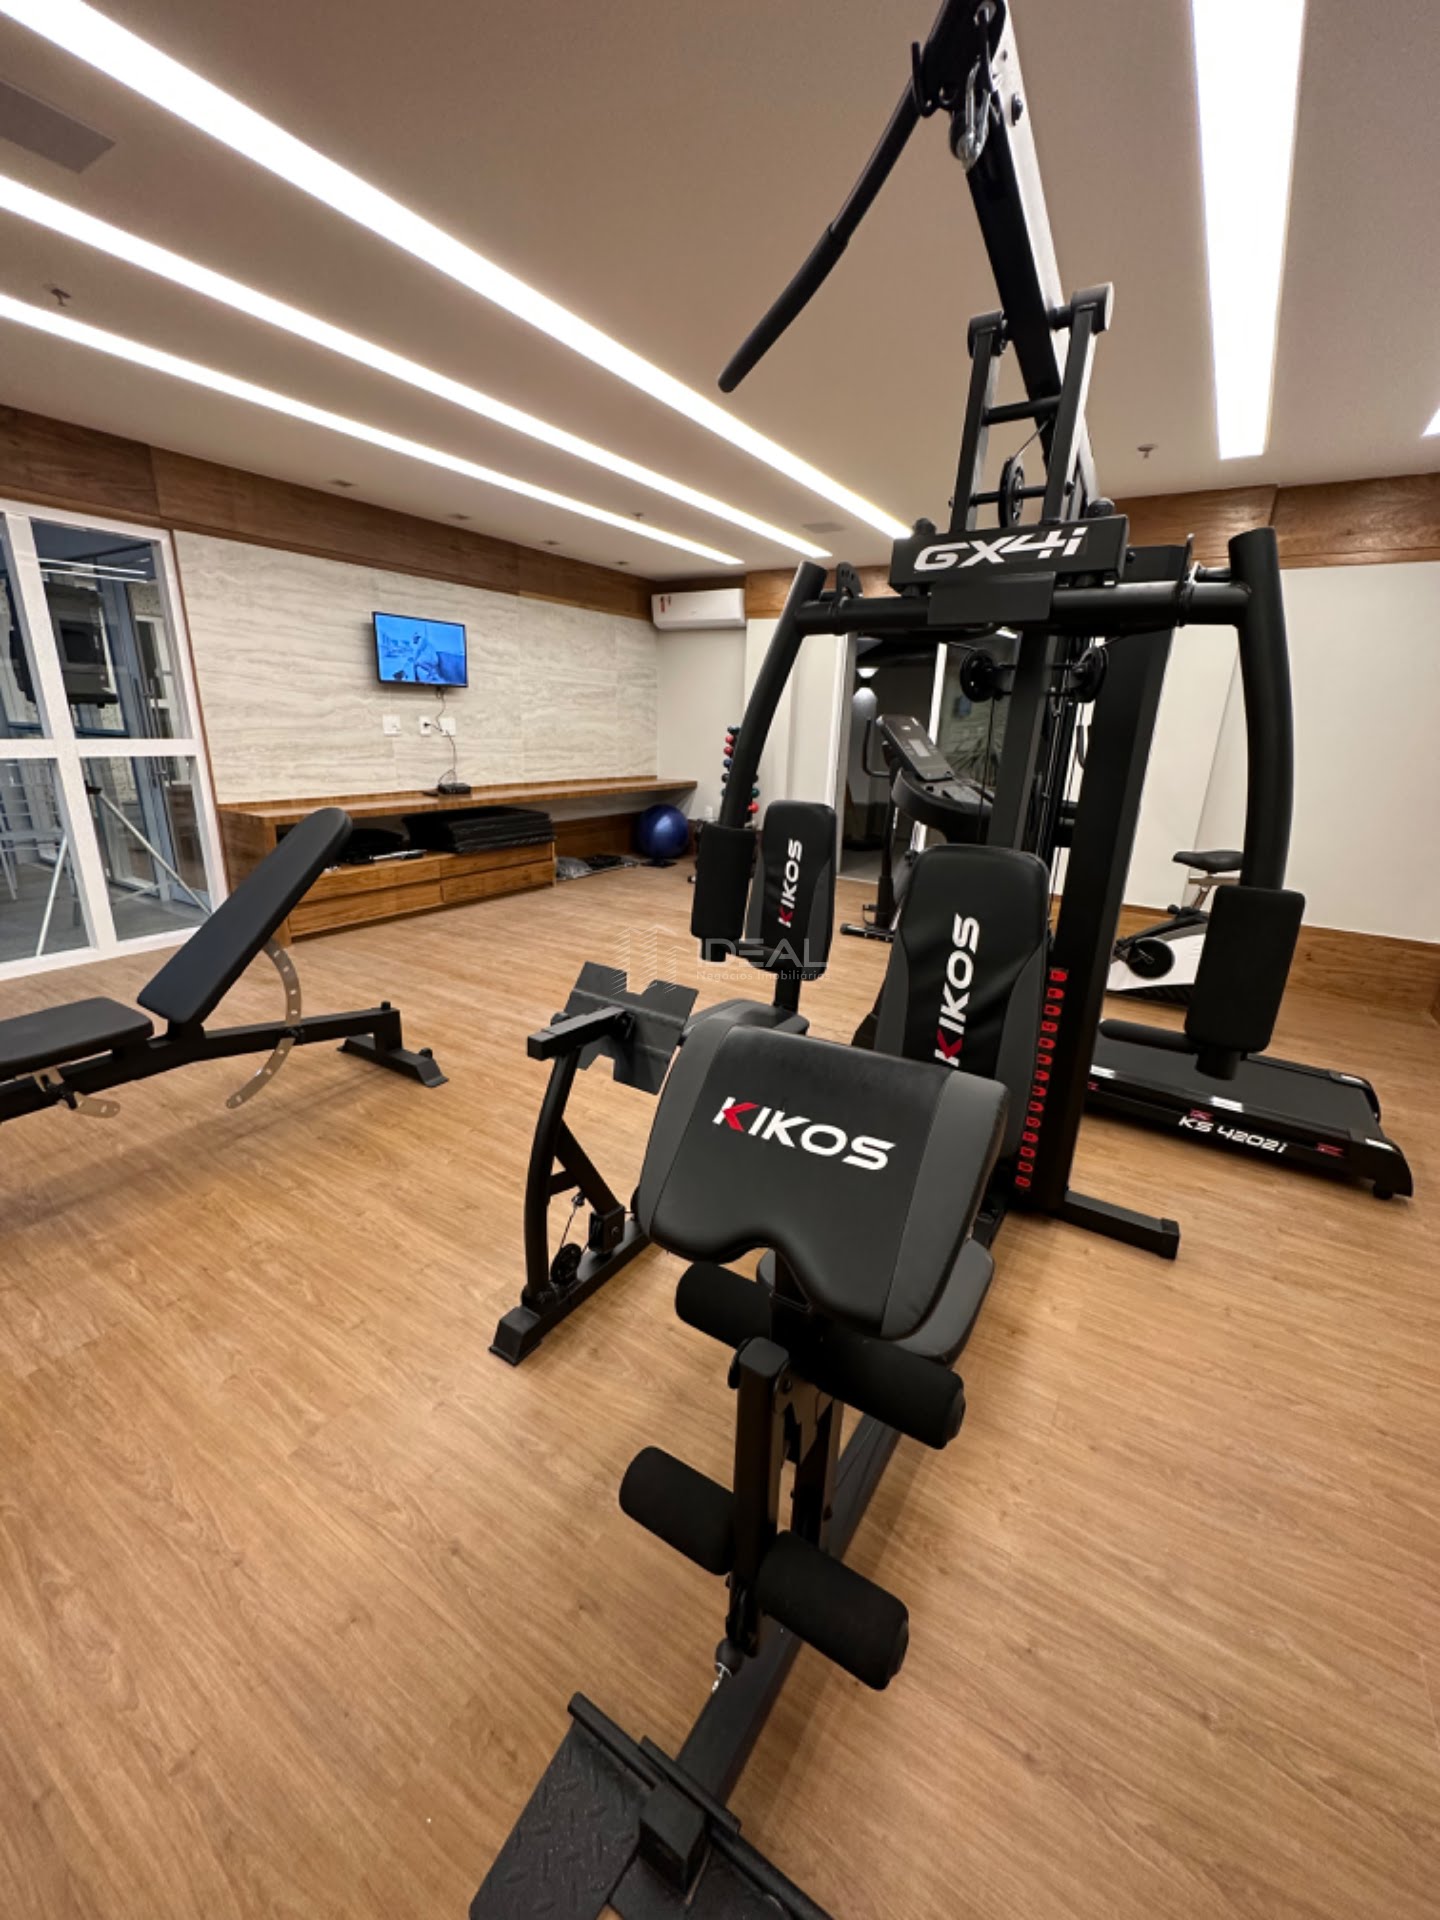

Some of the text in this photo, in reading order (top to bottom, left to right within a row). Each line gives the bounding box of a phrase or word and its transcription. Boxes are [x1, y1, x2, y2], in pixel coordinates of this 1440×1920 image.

[914, 527, 1087, 571] GX4i
[778, 838, 802, 928] KIKOS
[934, 913, 980, 1067] KIKOS
[712, 1096, 896, 1171] KIKOS
[1178, 1116, 1288, 1153] KS 4202i
